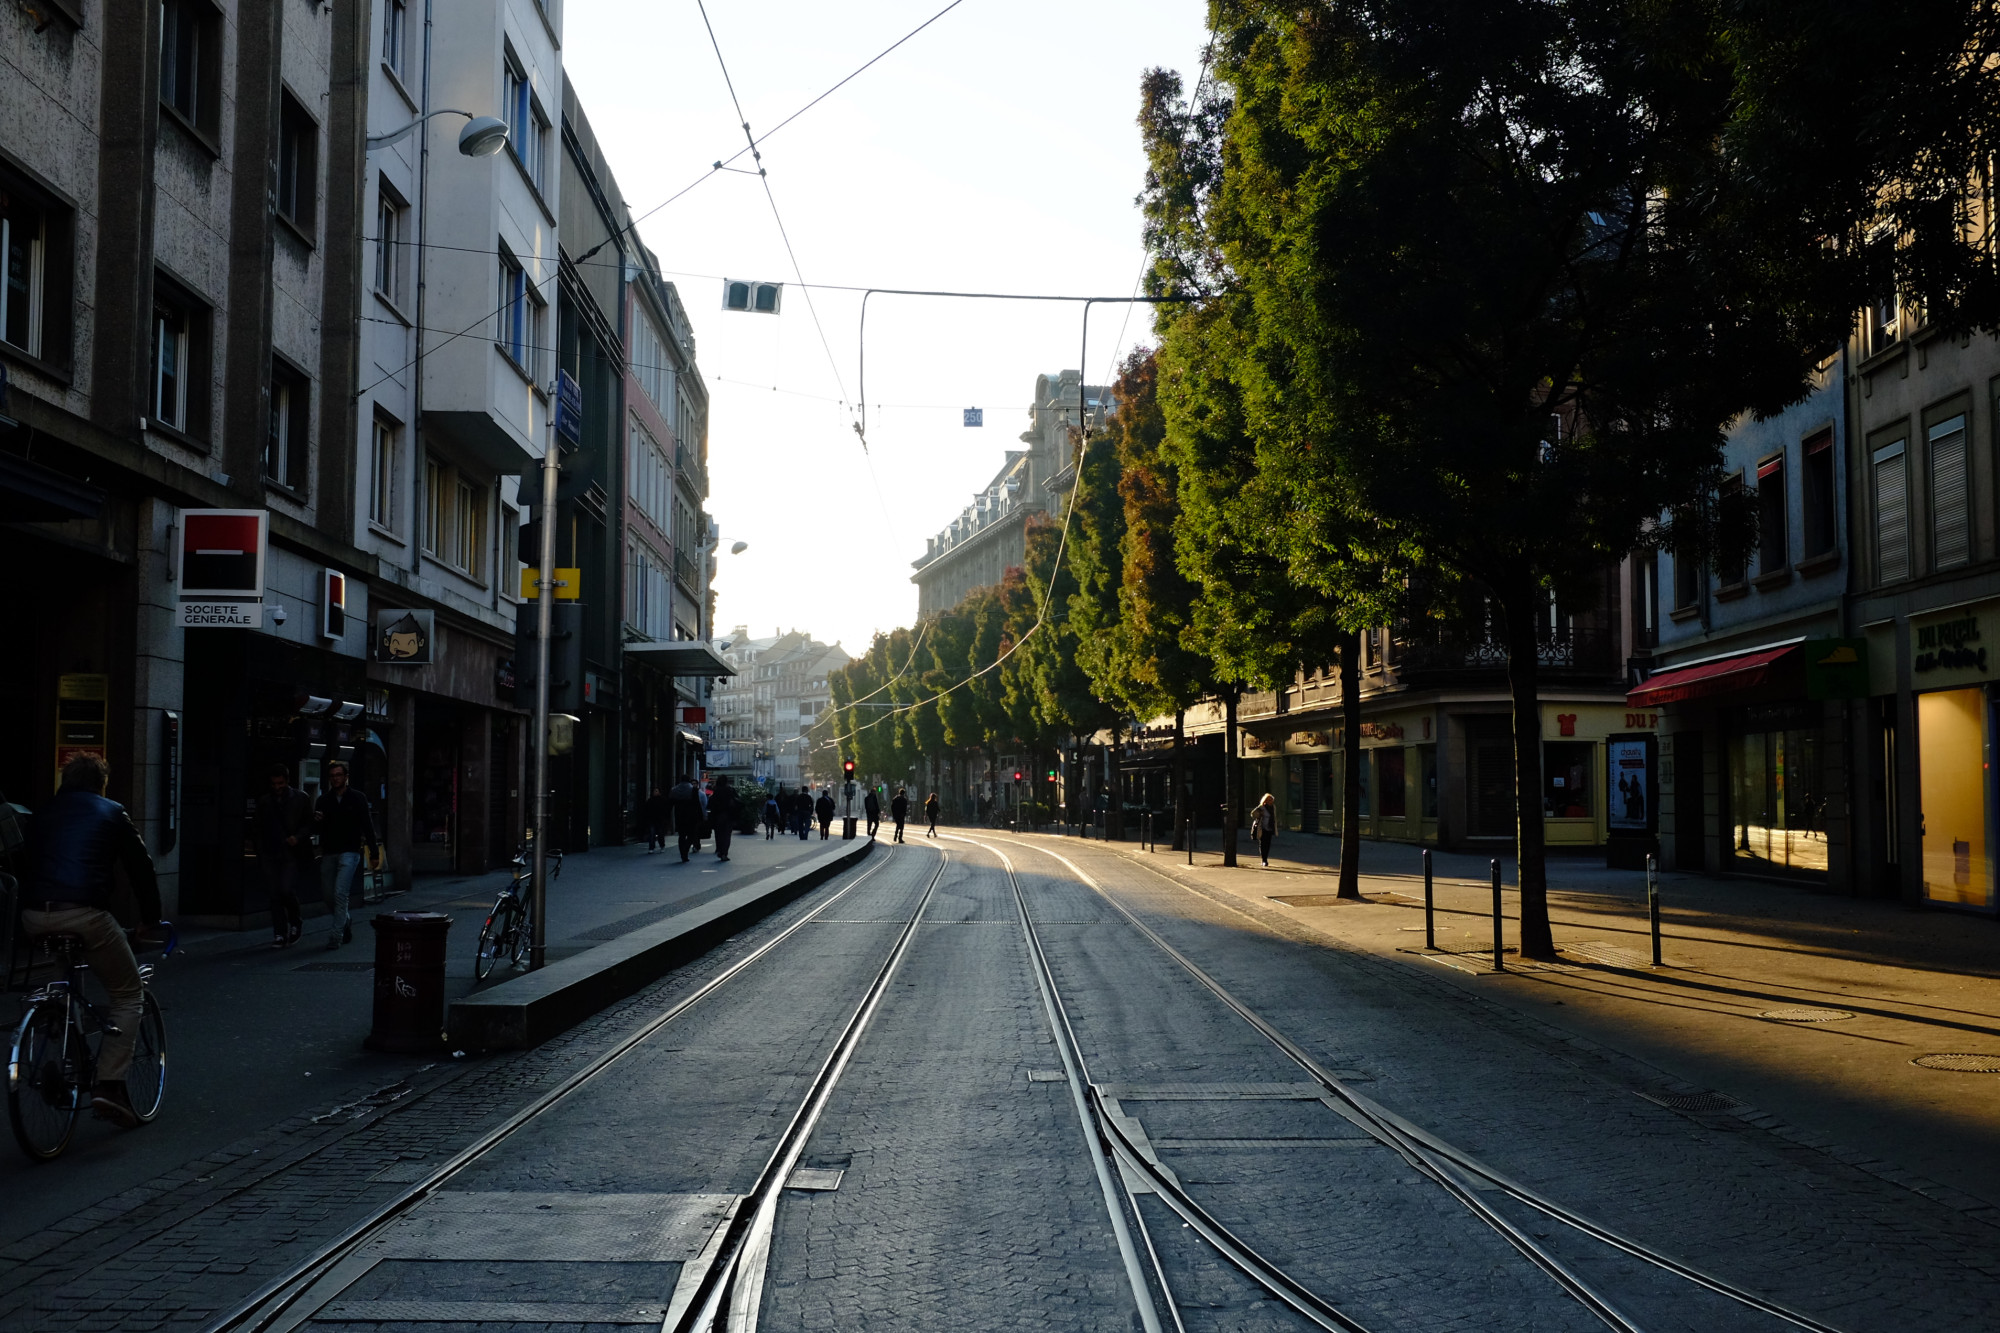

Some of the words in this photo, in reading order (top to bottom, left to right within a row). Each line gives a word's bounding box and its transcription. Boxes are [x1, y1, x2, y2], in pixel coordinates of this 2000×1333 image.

[964, 412, 982, 423] 250
[185, 605, 238, 614] SOCIETE
[184, 615, 251, 624] GENERALE
[1625, 713, 1646, 728] DU
